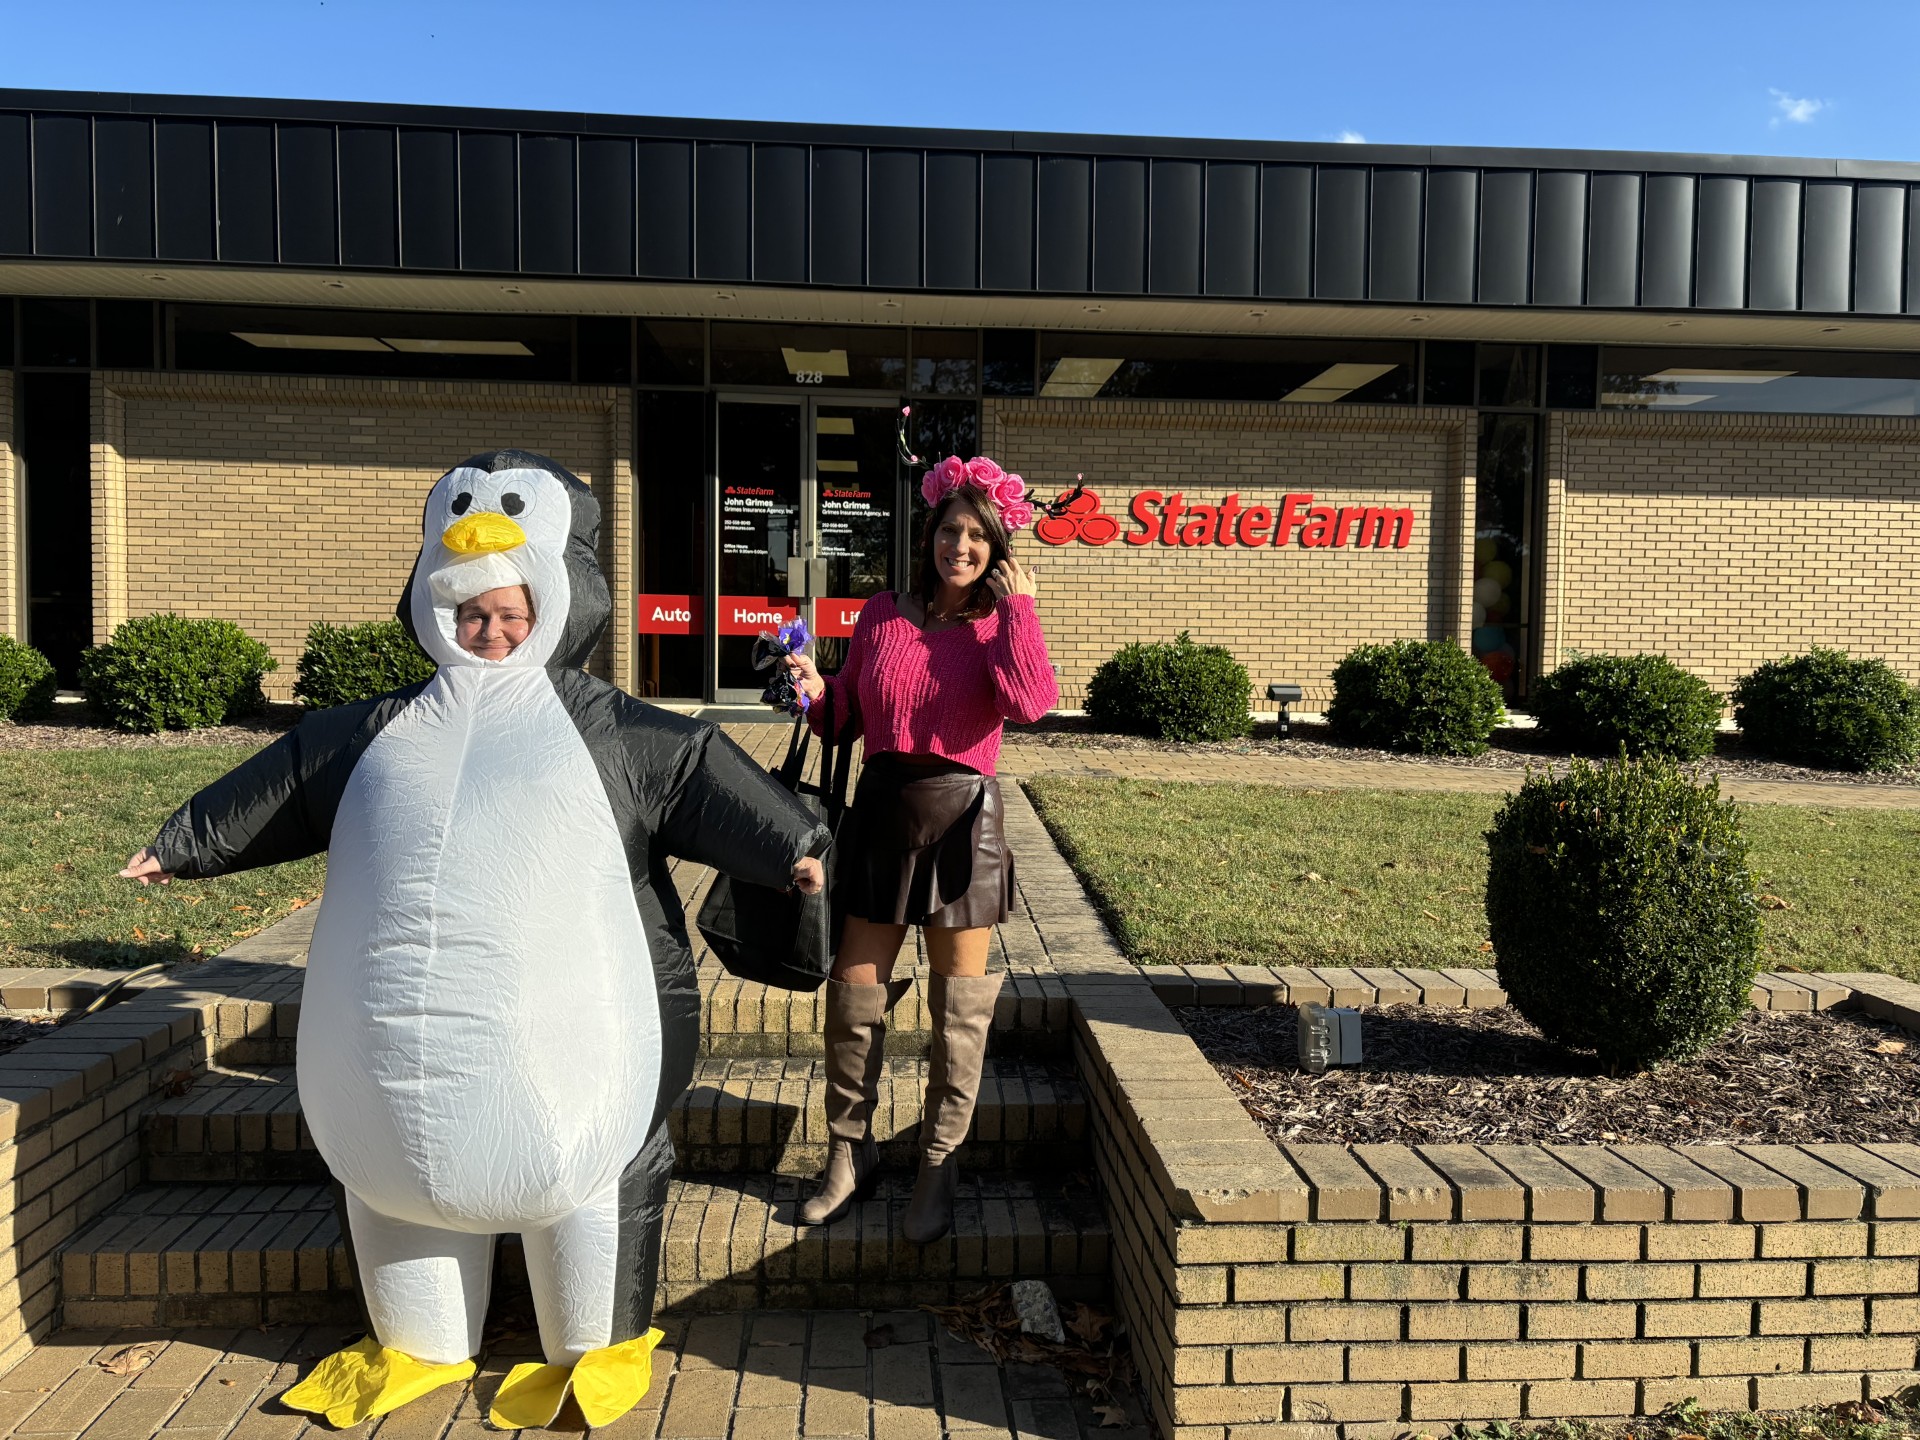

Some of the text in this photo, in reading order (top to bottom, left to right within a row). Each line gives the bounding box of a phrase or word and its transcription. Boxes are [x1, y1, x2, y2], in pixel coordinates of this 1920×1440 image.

[796, 370, 823, 384] 828
[724, 498, 773, 507] John Grimes
[822, 501, 870, 510] John Grimes
[652, 606, 691, 622] Auto
[734, 608, 783, 624] Home
[841, 611, 860, 625] Lif
